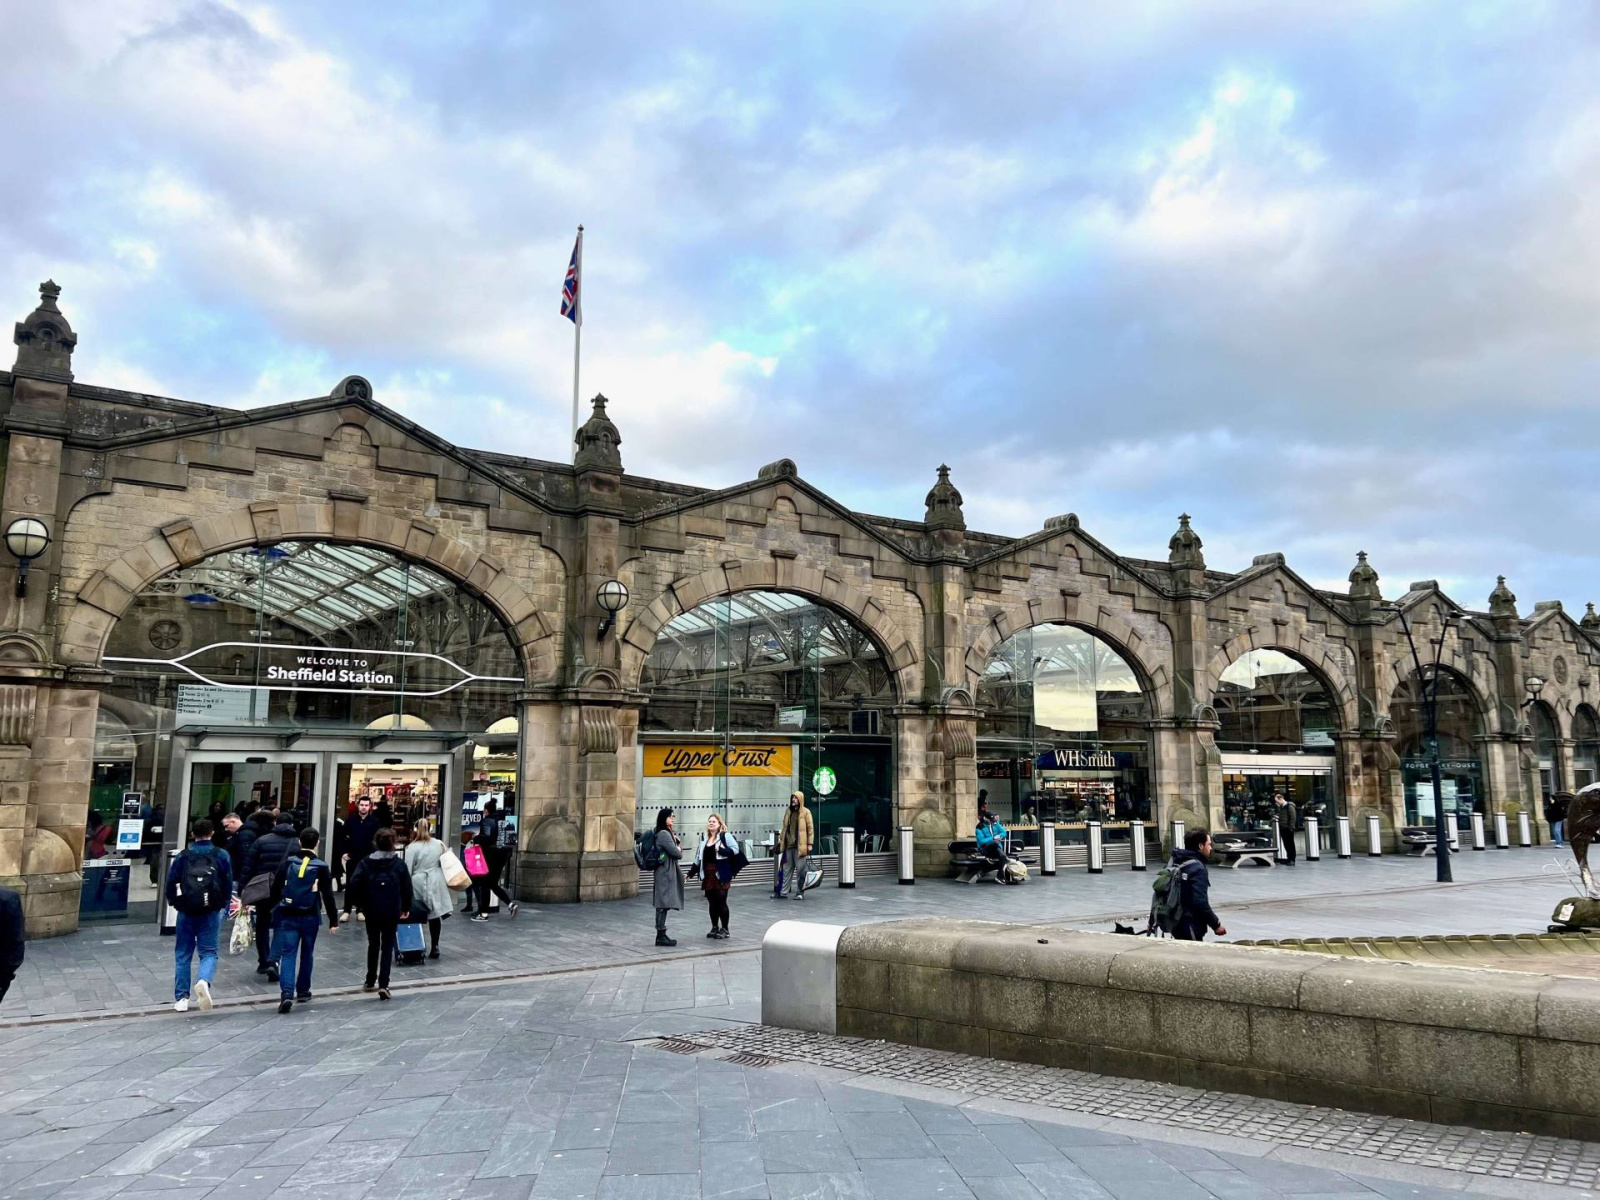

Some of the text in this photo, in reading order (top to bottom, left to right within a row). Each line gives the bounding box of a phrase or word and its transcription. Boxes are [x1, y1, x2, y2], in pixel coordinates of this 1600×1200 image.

[297, 656, 367, 667] WELCOME TO
[267, 666, 394, 684] Sheffield Station
[661, 748, 777, 773] Upper Crust
[1055, 750, 1115, 766] WHSmith
